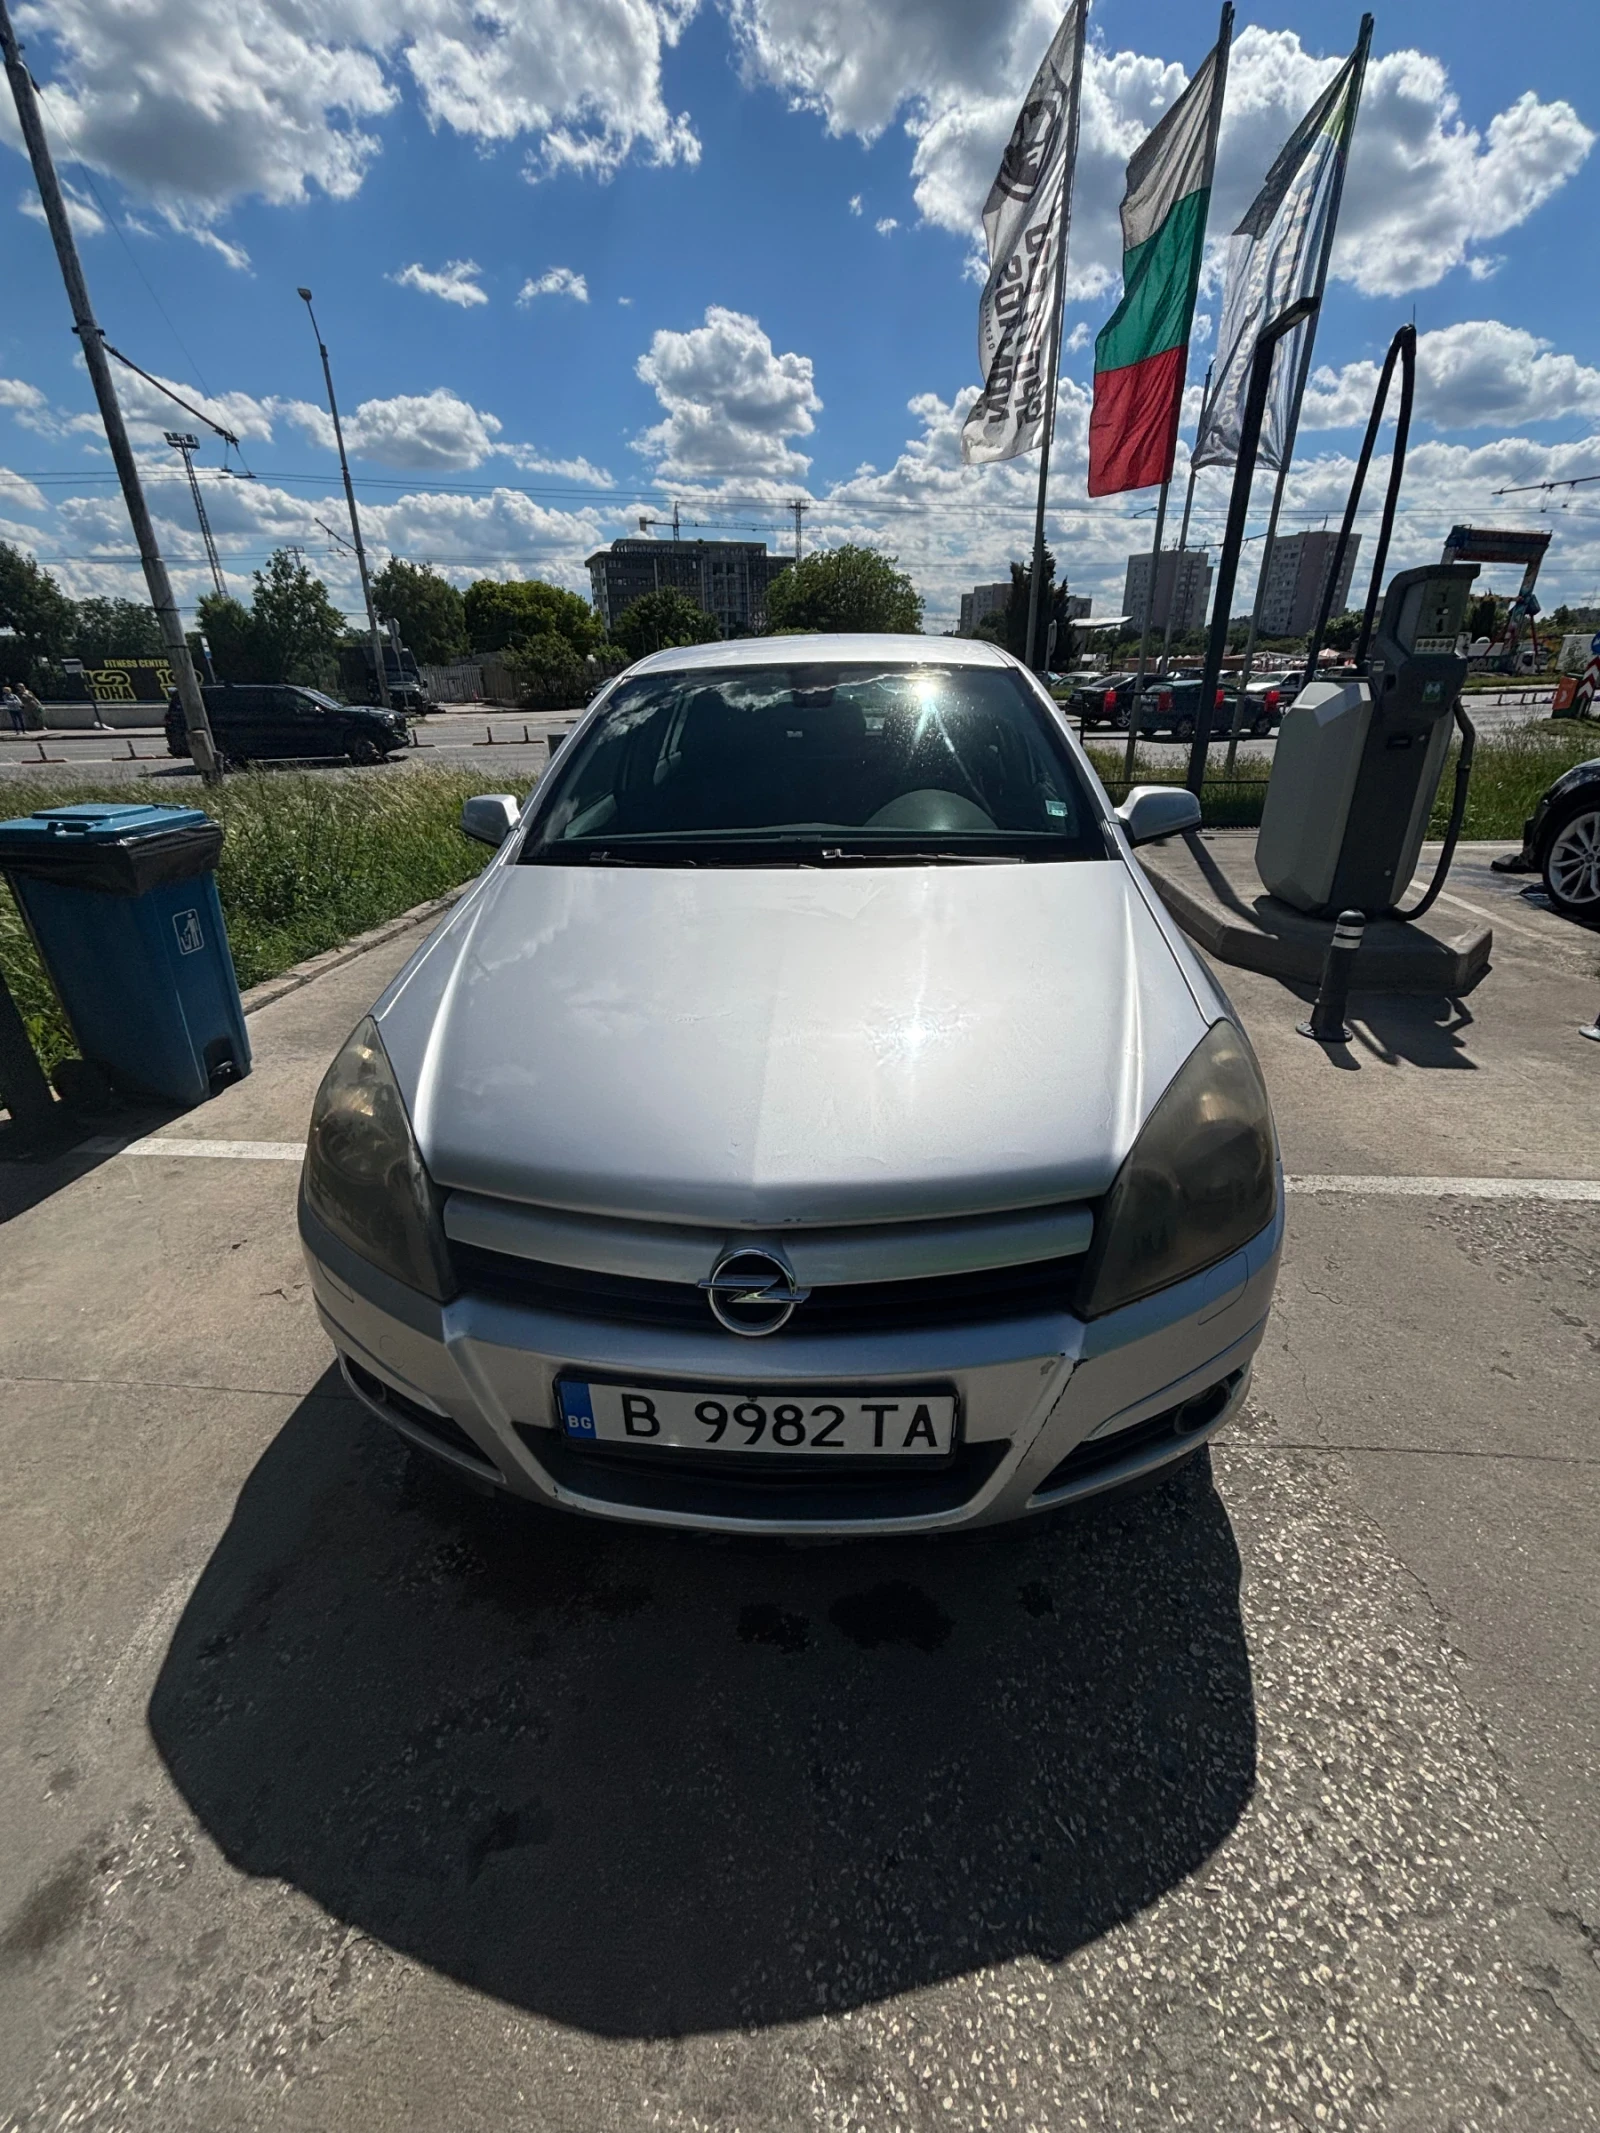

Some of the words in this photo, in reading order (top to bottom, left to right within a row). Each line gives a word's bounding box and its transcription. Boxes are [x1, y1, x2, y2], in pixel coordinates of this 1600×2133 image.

[104, 660, 138, 668] FITNESS
[139, 659, 170, 668] CENTER
[567, 1414, 592, 1430] BG
[620, 1394, 661, 1438] B
[694, 1400, 846, 1448] 9982
[860, 1403, 939, 1448] TA
